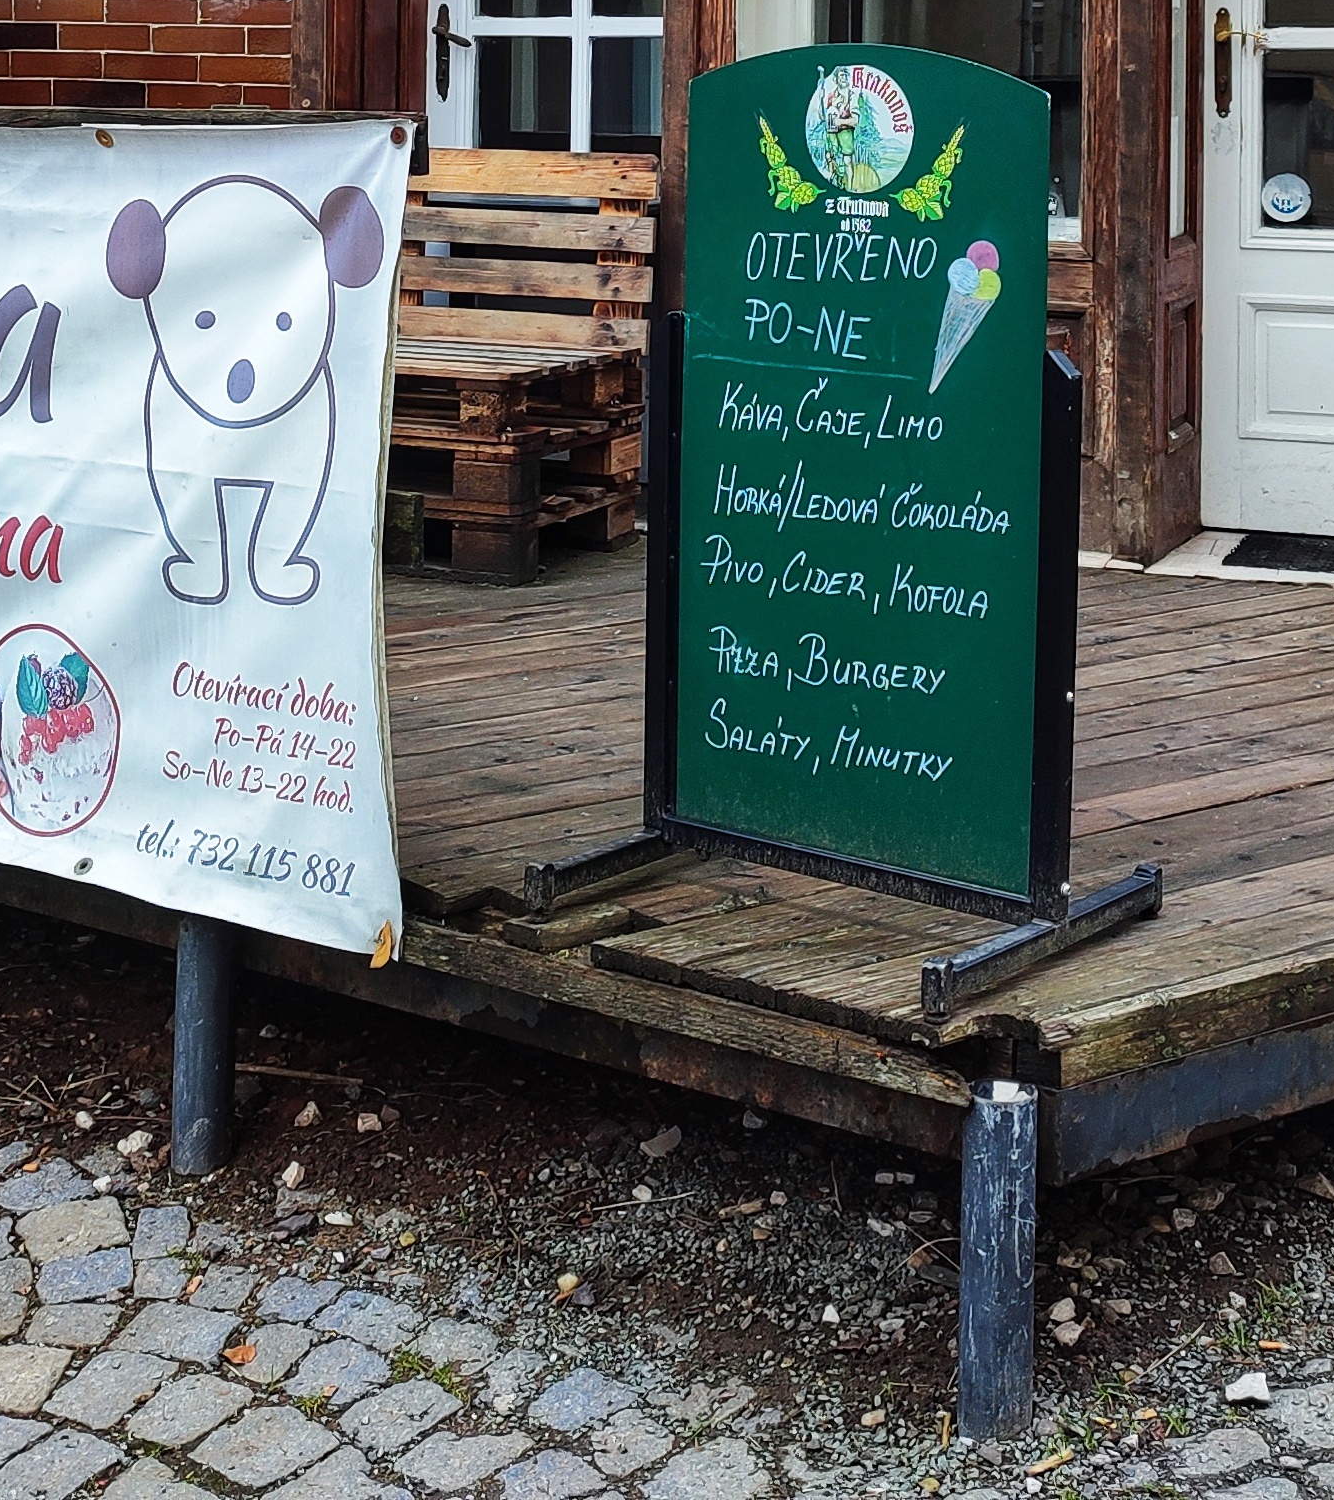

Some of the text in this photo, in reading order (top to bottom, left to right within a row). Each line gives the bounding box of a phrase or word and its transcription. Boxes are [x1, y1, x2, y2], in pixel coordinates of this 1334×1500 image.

[746, 232, 937, 282] OTEVŘENO
[744, 298, 872, 360] PO-NE
[877, 395, 942, 440] LIMO
[892, 483, 1011, 534] ČOKOLÁDA
[890, 564, 988, 618] KOFOLA
[794, 633, 945, 694] BURGERY
[172, 661, 357, 725] Otevírací doba:
[214, 717, 356, 769] Po-Pá 14-22
[831, 726, 952, 781] MINUTKY
[163, 751, 354, 813] So-Ne 13-22 hod.
[136, 819, 356, 898] tel.: 732 115 881
